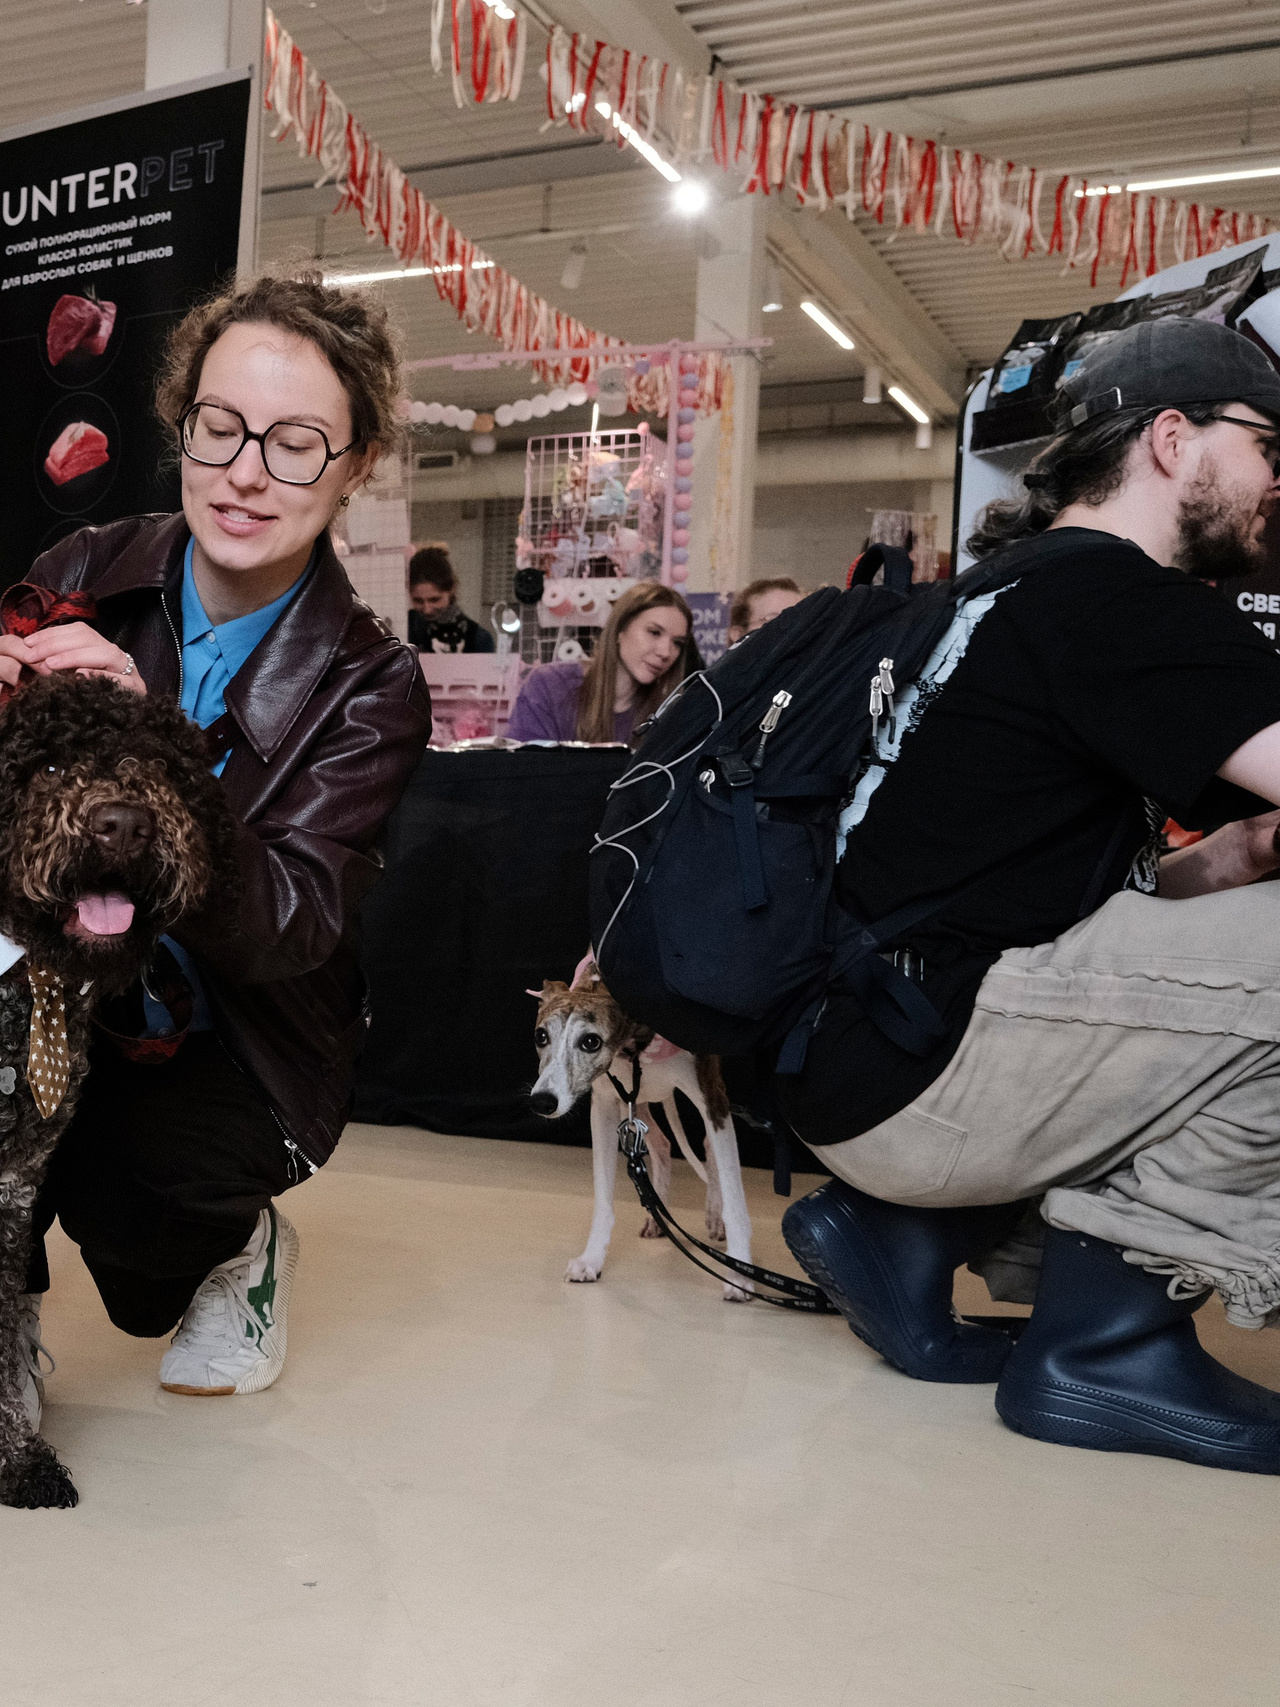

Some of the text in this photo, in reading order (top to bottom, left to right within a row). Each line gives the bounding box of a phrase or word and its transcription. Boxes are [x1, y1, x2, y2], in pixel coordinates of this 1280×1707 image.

[5, 210, 172, 256] СУХОЙ ПОЛНОРАЦИОННЫЙ КОРМ
[37, 236, 133, 266] КЛАССА ХОЛИСТИК
[1, 245, 174, 291] ДЛЯ ВЗРОСЛЫХ СОБАК И ЩЕНКОВ
[1237, 592, 1280, 614] СВЕ
